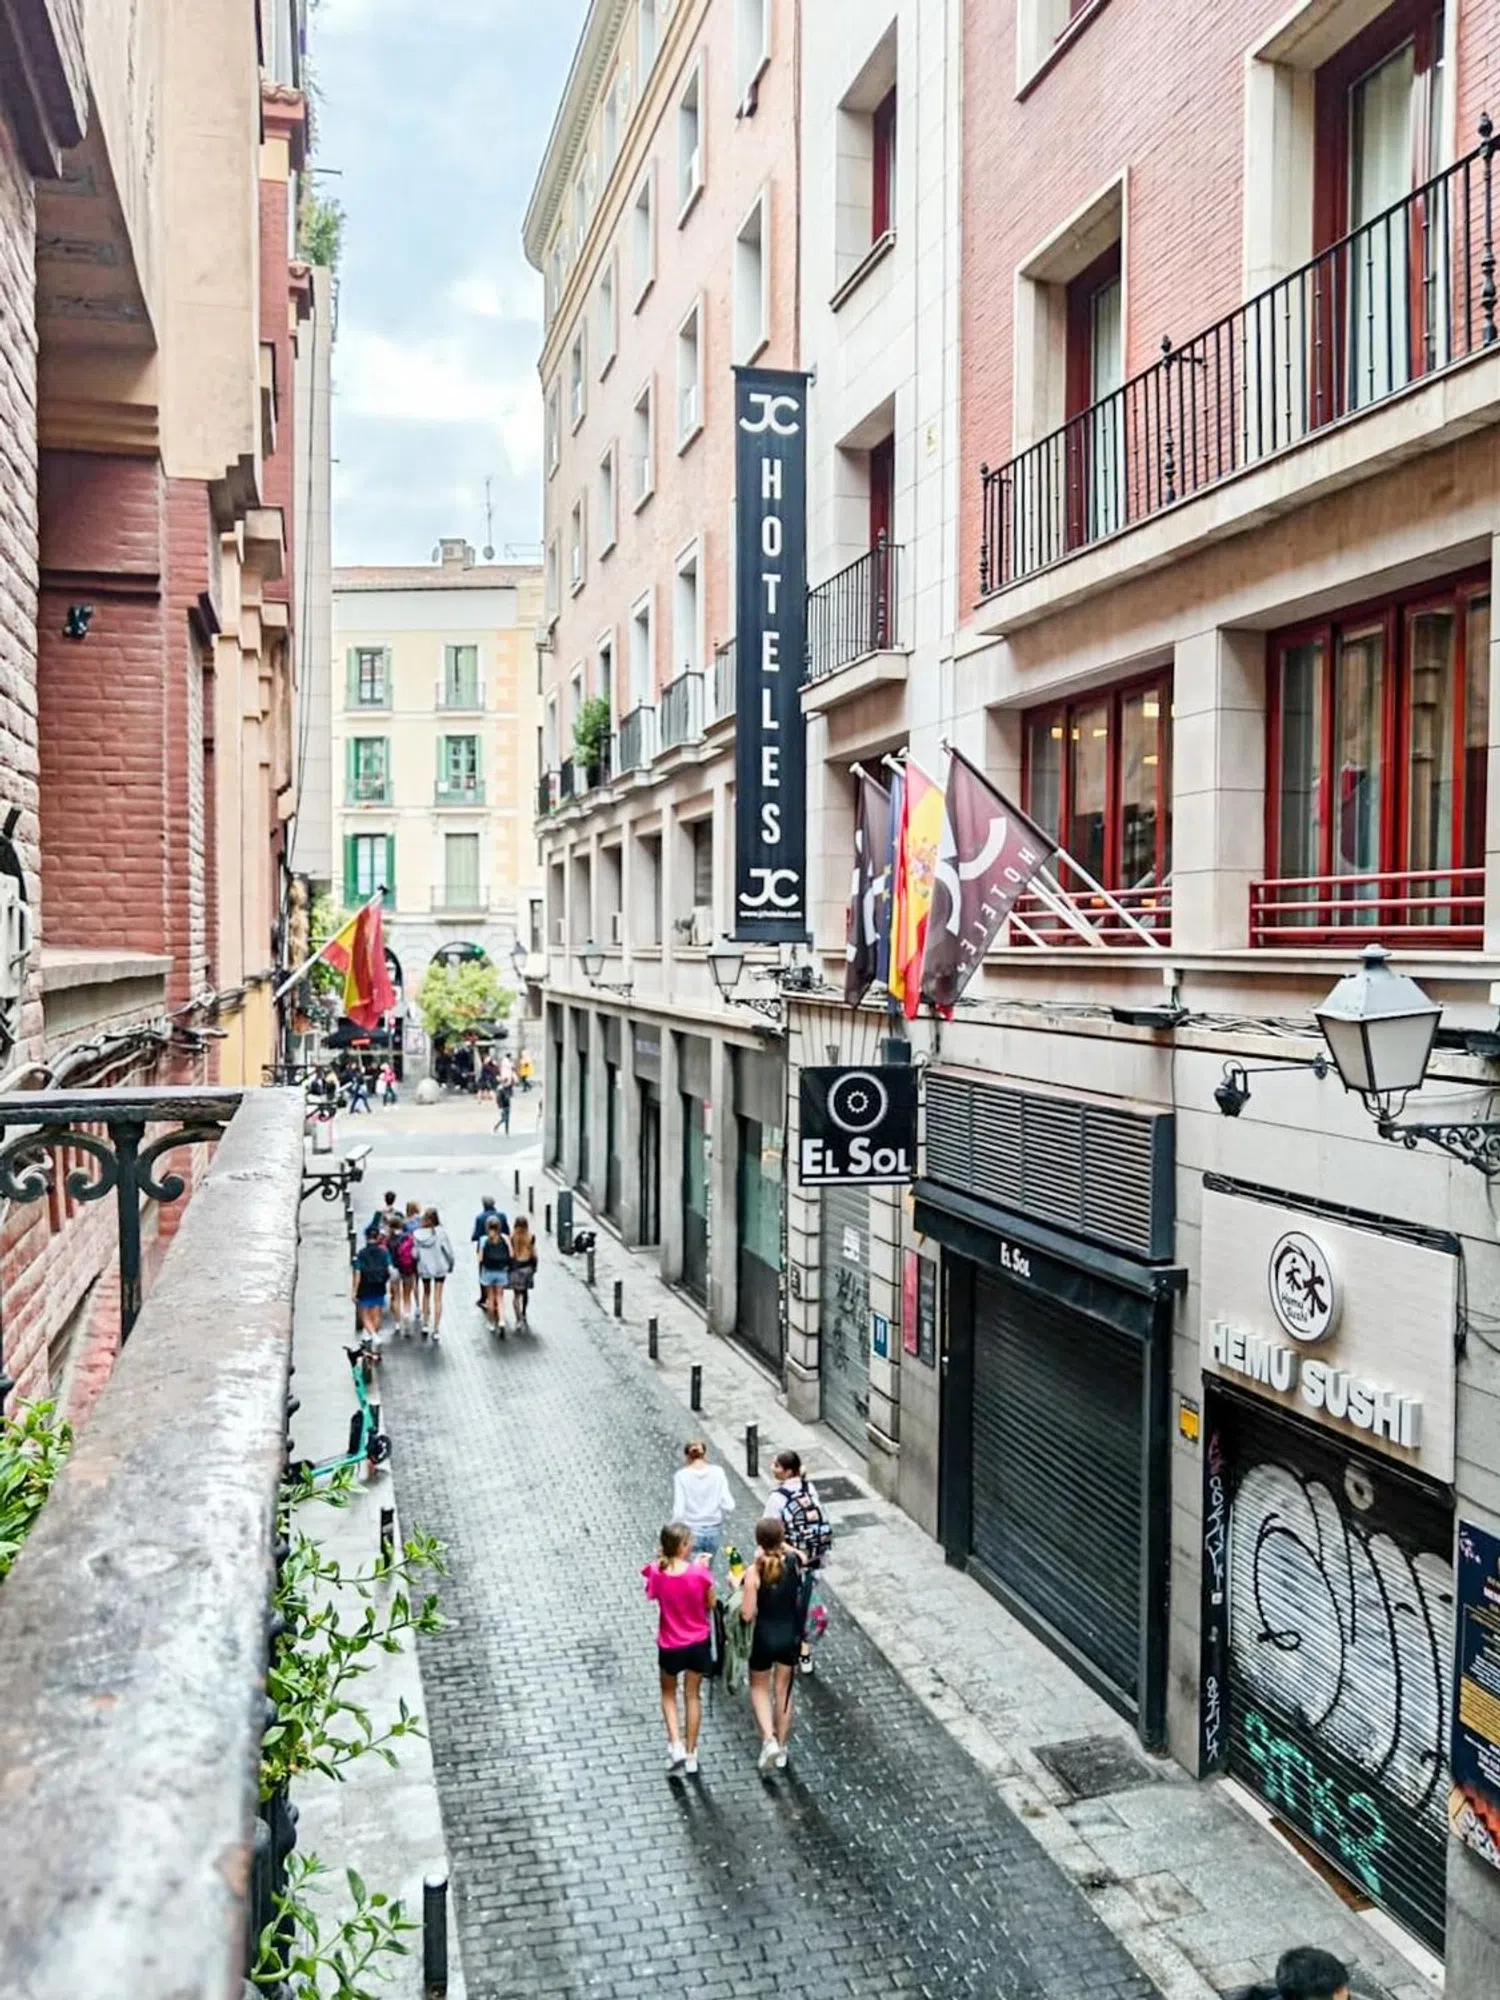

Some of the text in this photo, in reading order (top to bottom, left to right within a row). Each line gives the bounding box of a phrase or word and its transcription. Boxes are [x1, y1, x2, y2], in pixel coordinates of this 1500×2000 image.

[739, 393, 799, 434] JC
[761, 457, 782, 845] HOTELES
[739, 867, 799, 907] JC
[1208, 1319, 1422, 1449] HEMU SUSHI
